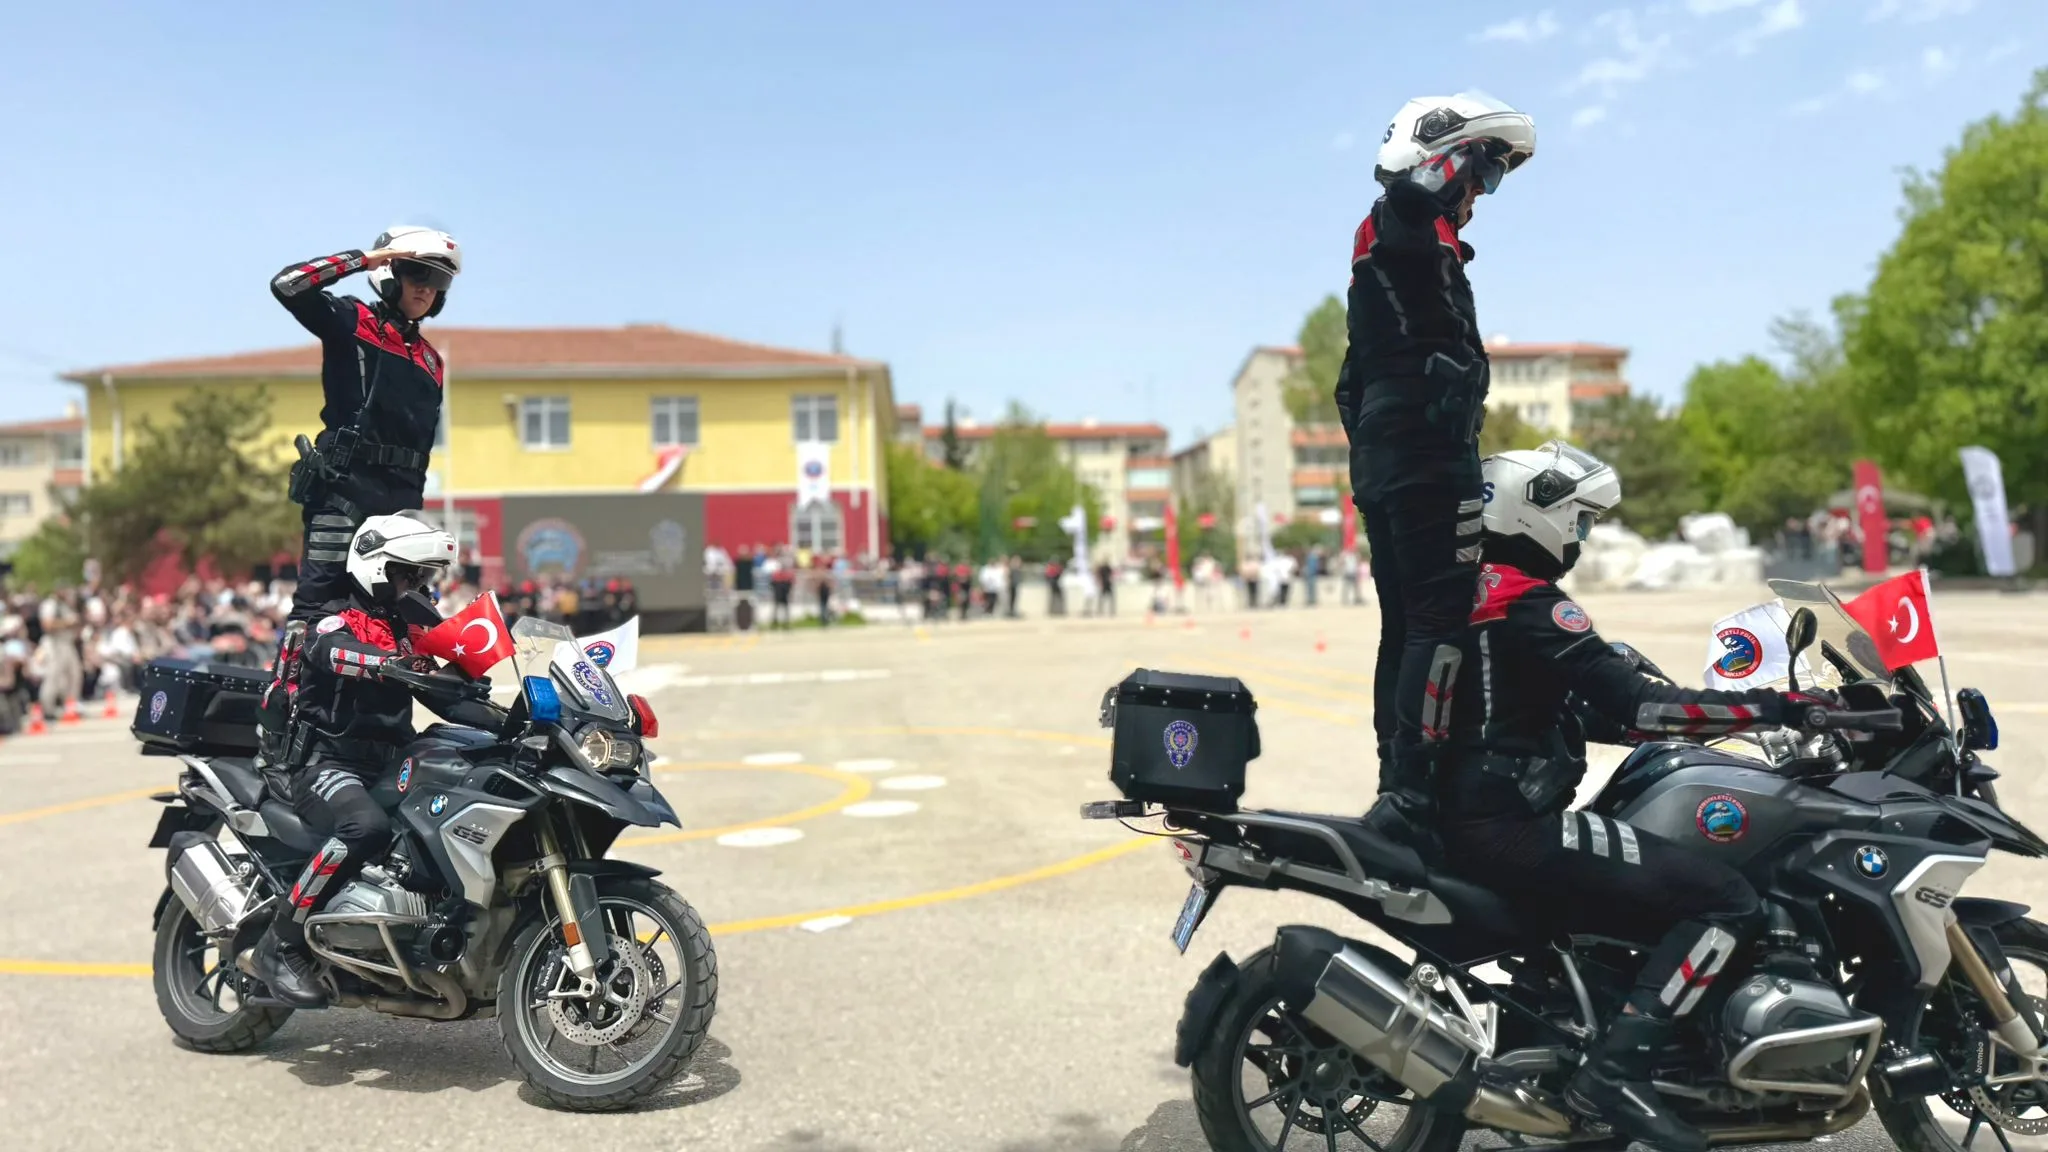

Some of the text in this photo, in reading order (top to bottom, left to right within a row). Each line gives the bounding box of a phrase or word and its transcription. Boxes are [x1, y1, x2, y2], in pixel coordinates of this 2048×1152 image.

[453, 824, 489, 845] GS
[1915, 886, 1952, 909] GS
[1975, 1041, 1984, 1074] brembo
